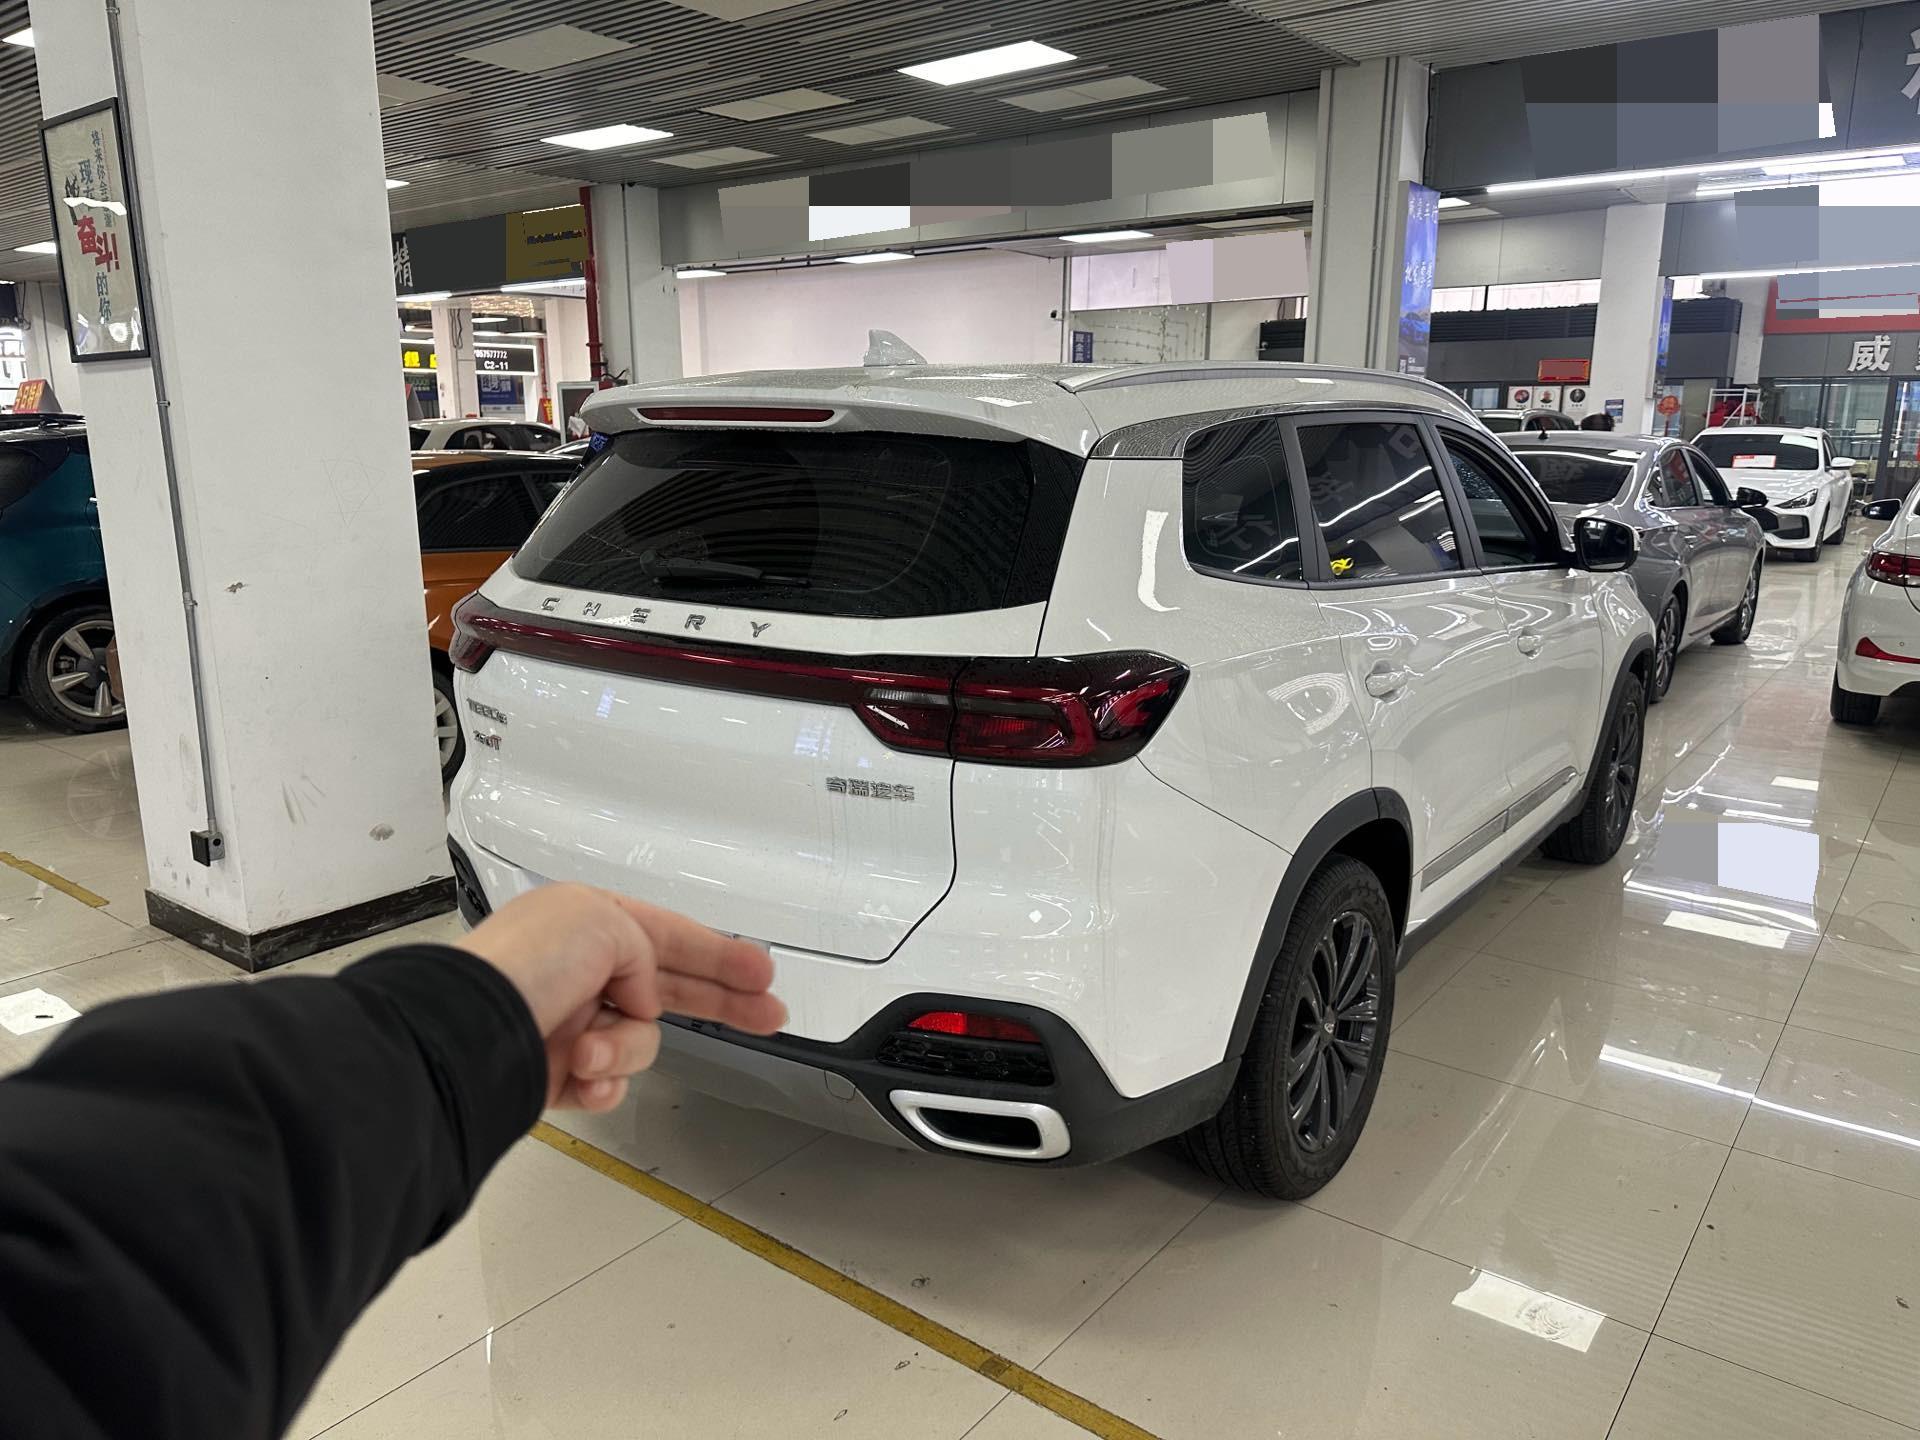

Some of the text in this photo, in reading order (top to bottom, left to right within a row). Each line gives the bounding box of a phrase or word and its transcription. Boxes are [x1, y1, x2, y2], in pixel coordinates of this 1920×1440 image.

[484, 360, 509, 370] C2-11
[540, 597, 771, 638] CHERY
[825, 776, 915, 801] 奇瑞汽车
